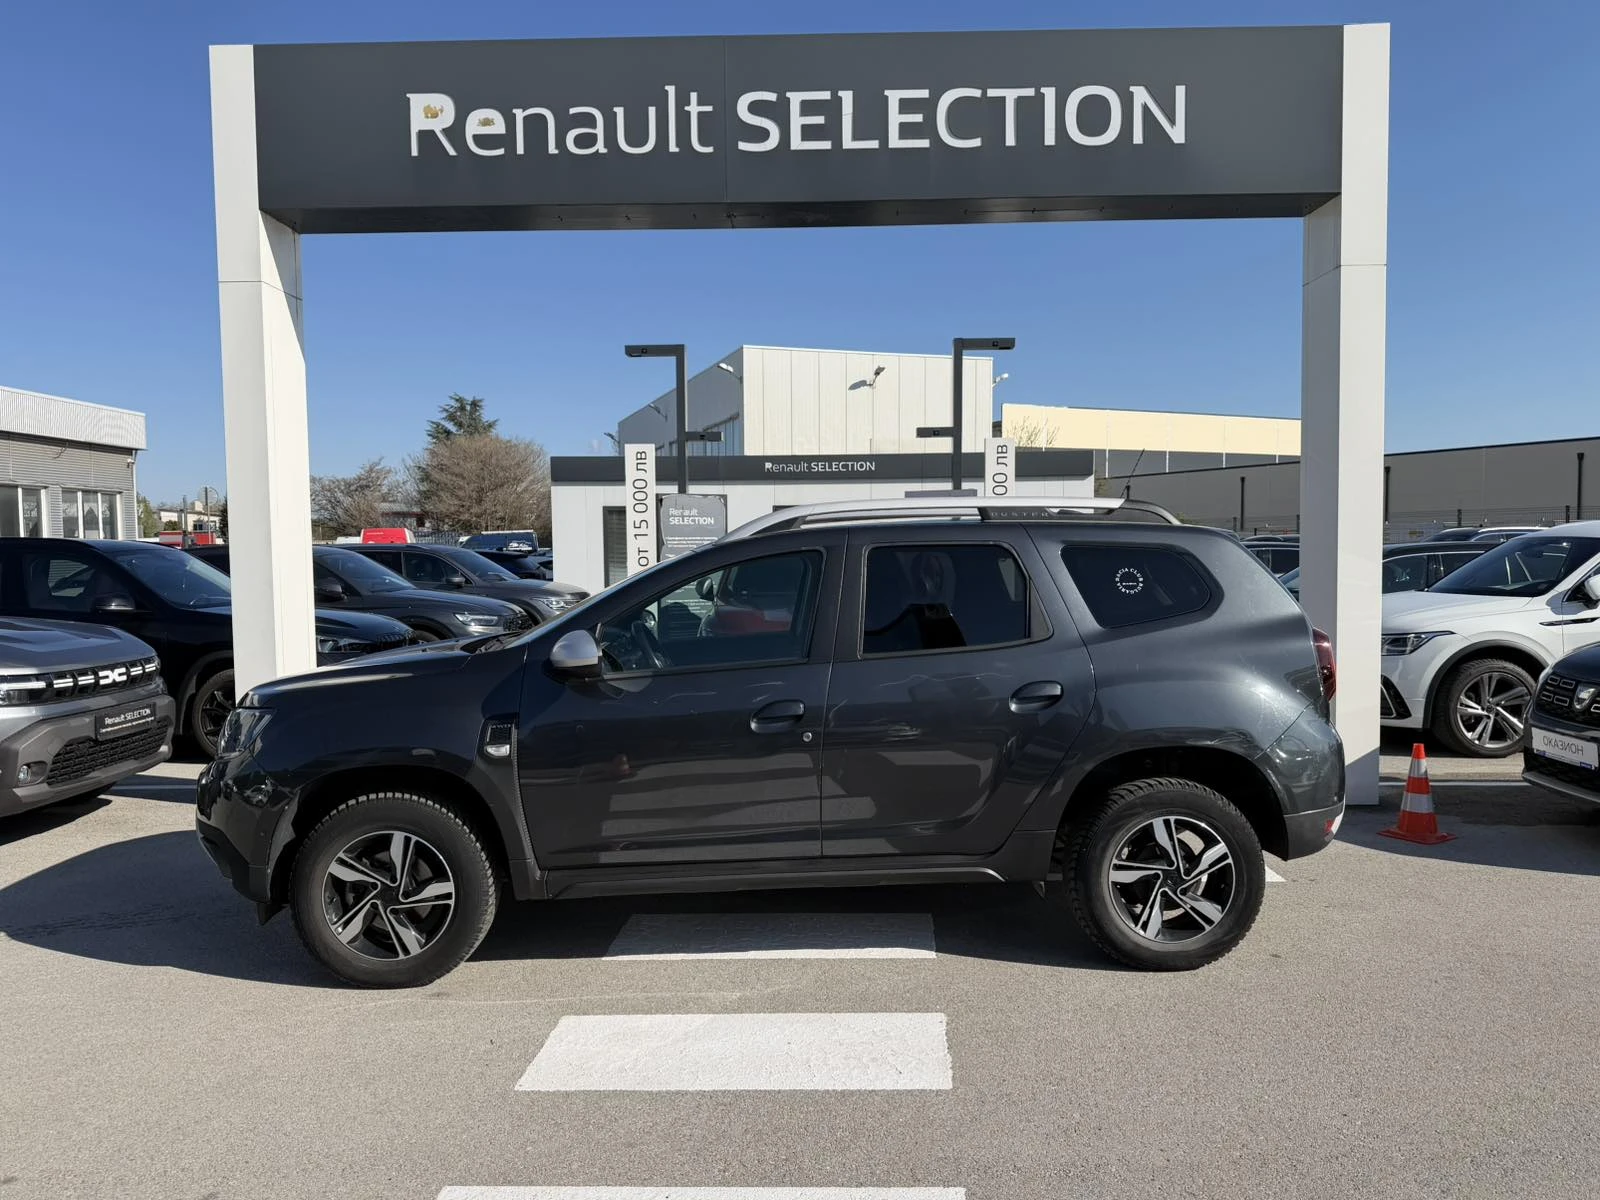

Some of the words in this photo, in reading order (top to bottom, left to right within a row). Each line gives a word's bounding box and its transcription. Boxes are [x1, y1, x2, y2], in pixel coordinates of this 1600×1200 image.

[406, 85, 714, 156] Renault
[736, 85, 1187, 153] SELECTION
[764, 461, 809, 473] Renault
[810, 461, 876, 473] SELECTION
[632, 478, 648, 513] 000
[633, 519, 649, 539] 15
[669, 516, 715, 525] SELECTION
[1542, 736, 1584, 756] ОКАЗИОН
